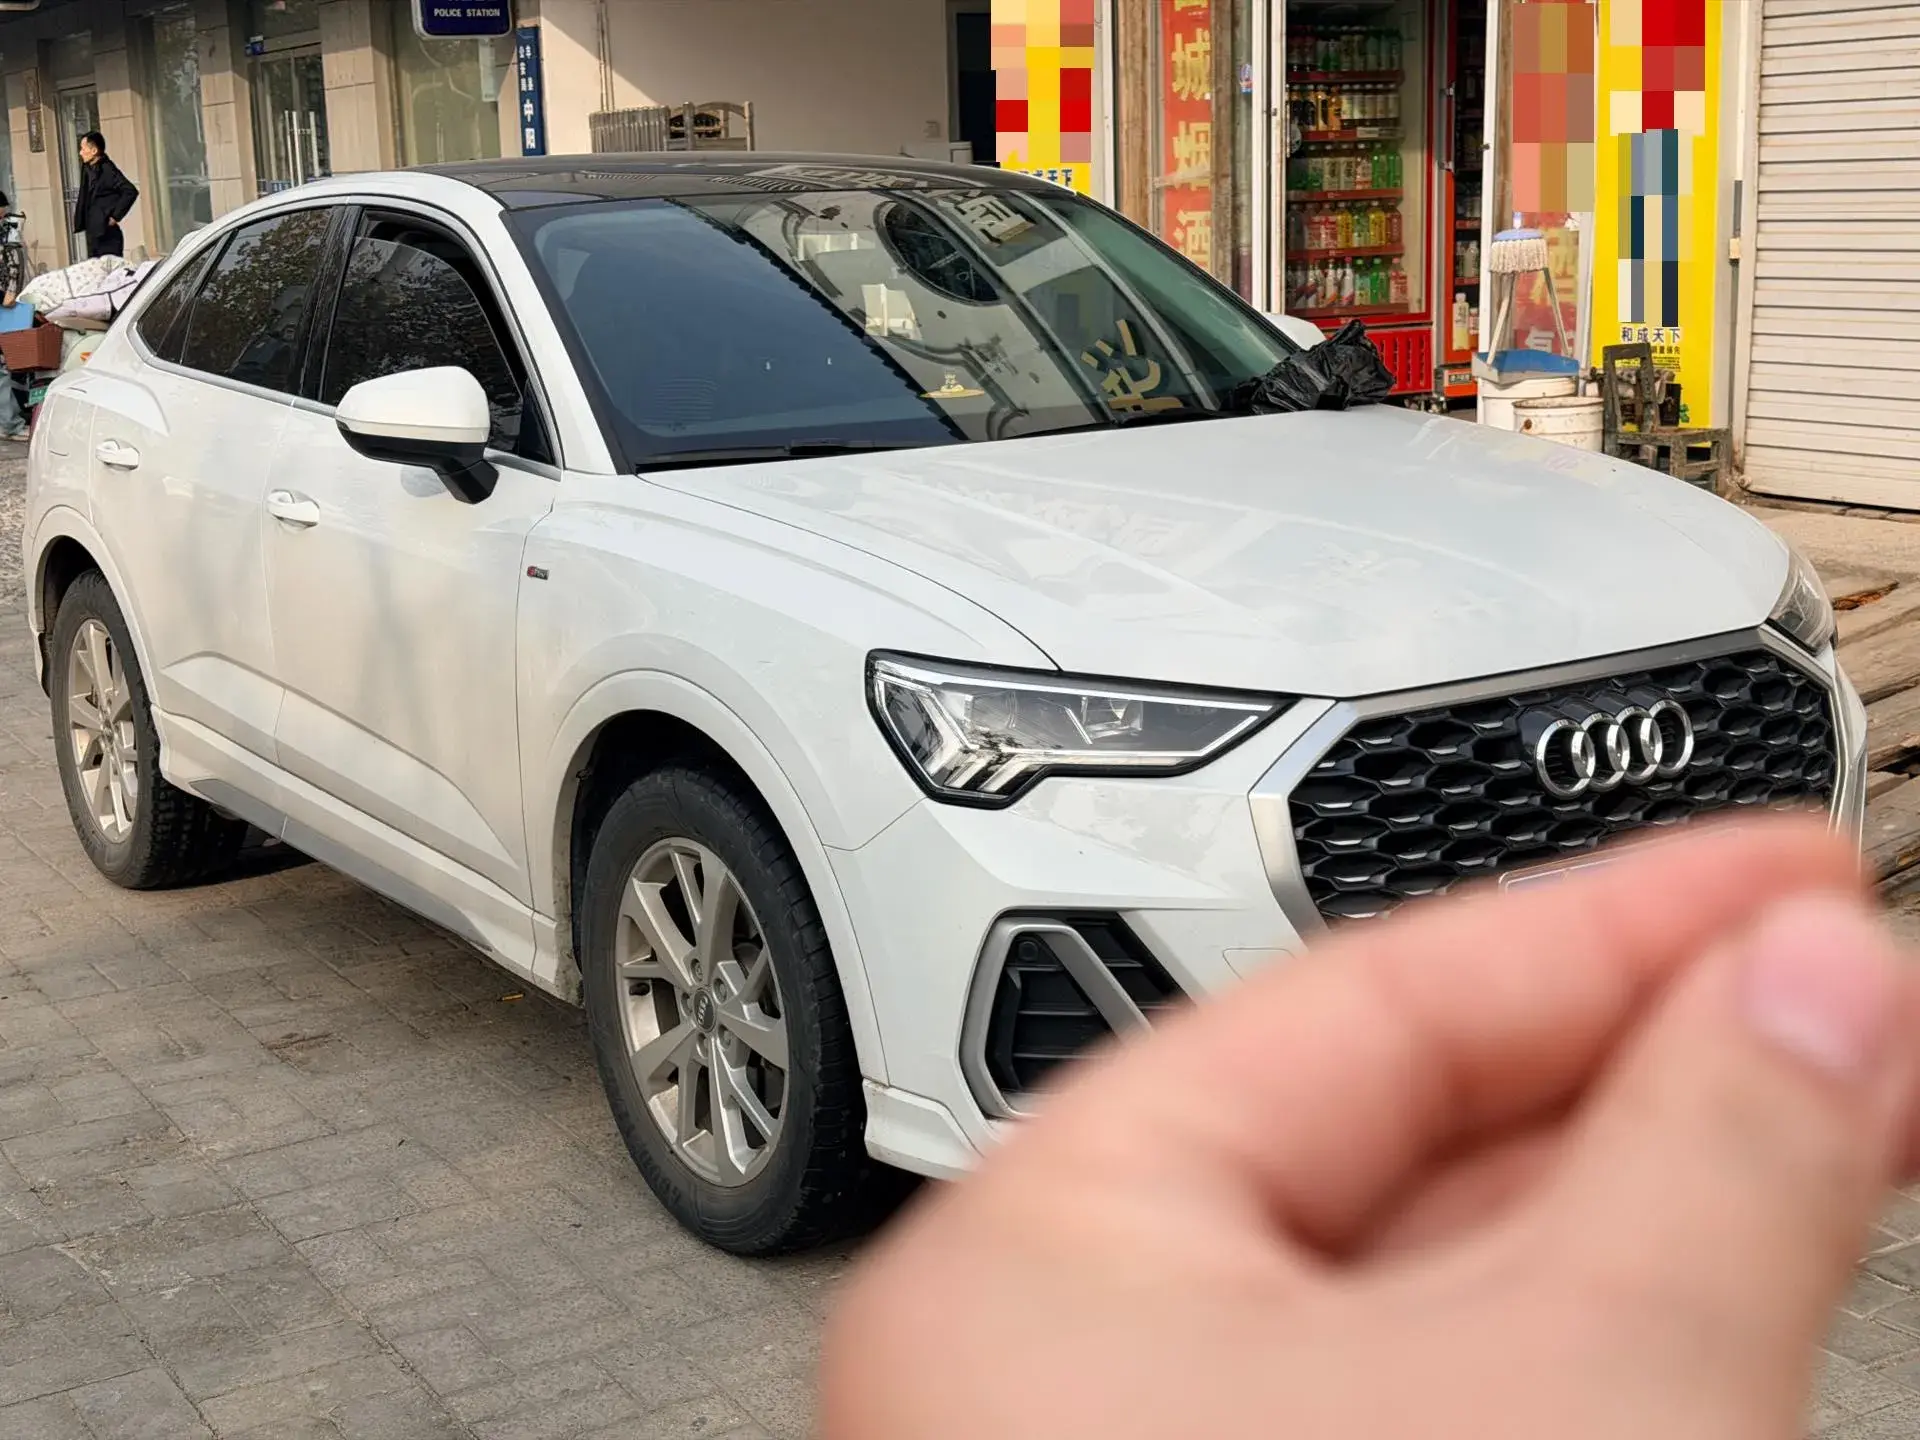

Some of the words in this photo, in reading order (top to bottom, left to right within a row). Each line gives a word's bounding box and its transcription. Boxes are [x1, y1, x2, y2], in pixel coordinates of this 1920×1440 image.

[433, 8, 462, 17] POLICE
[466, 8, 501, 17] STATION
[1621, 327, 1681, 343] 和成天下
